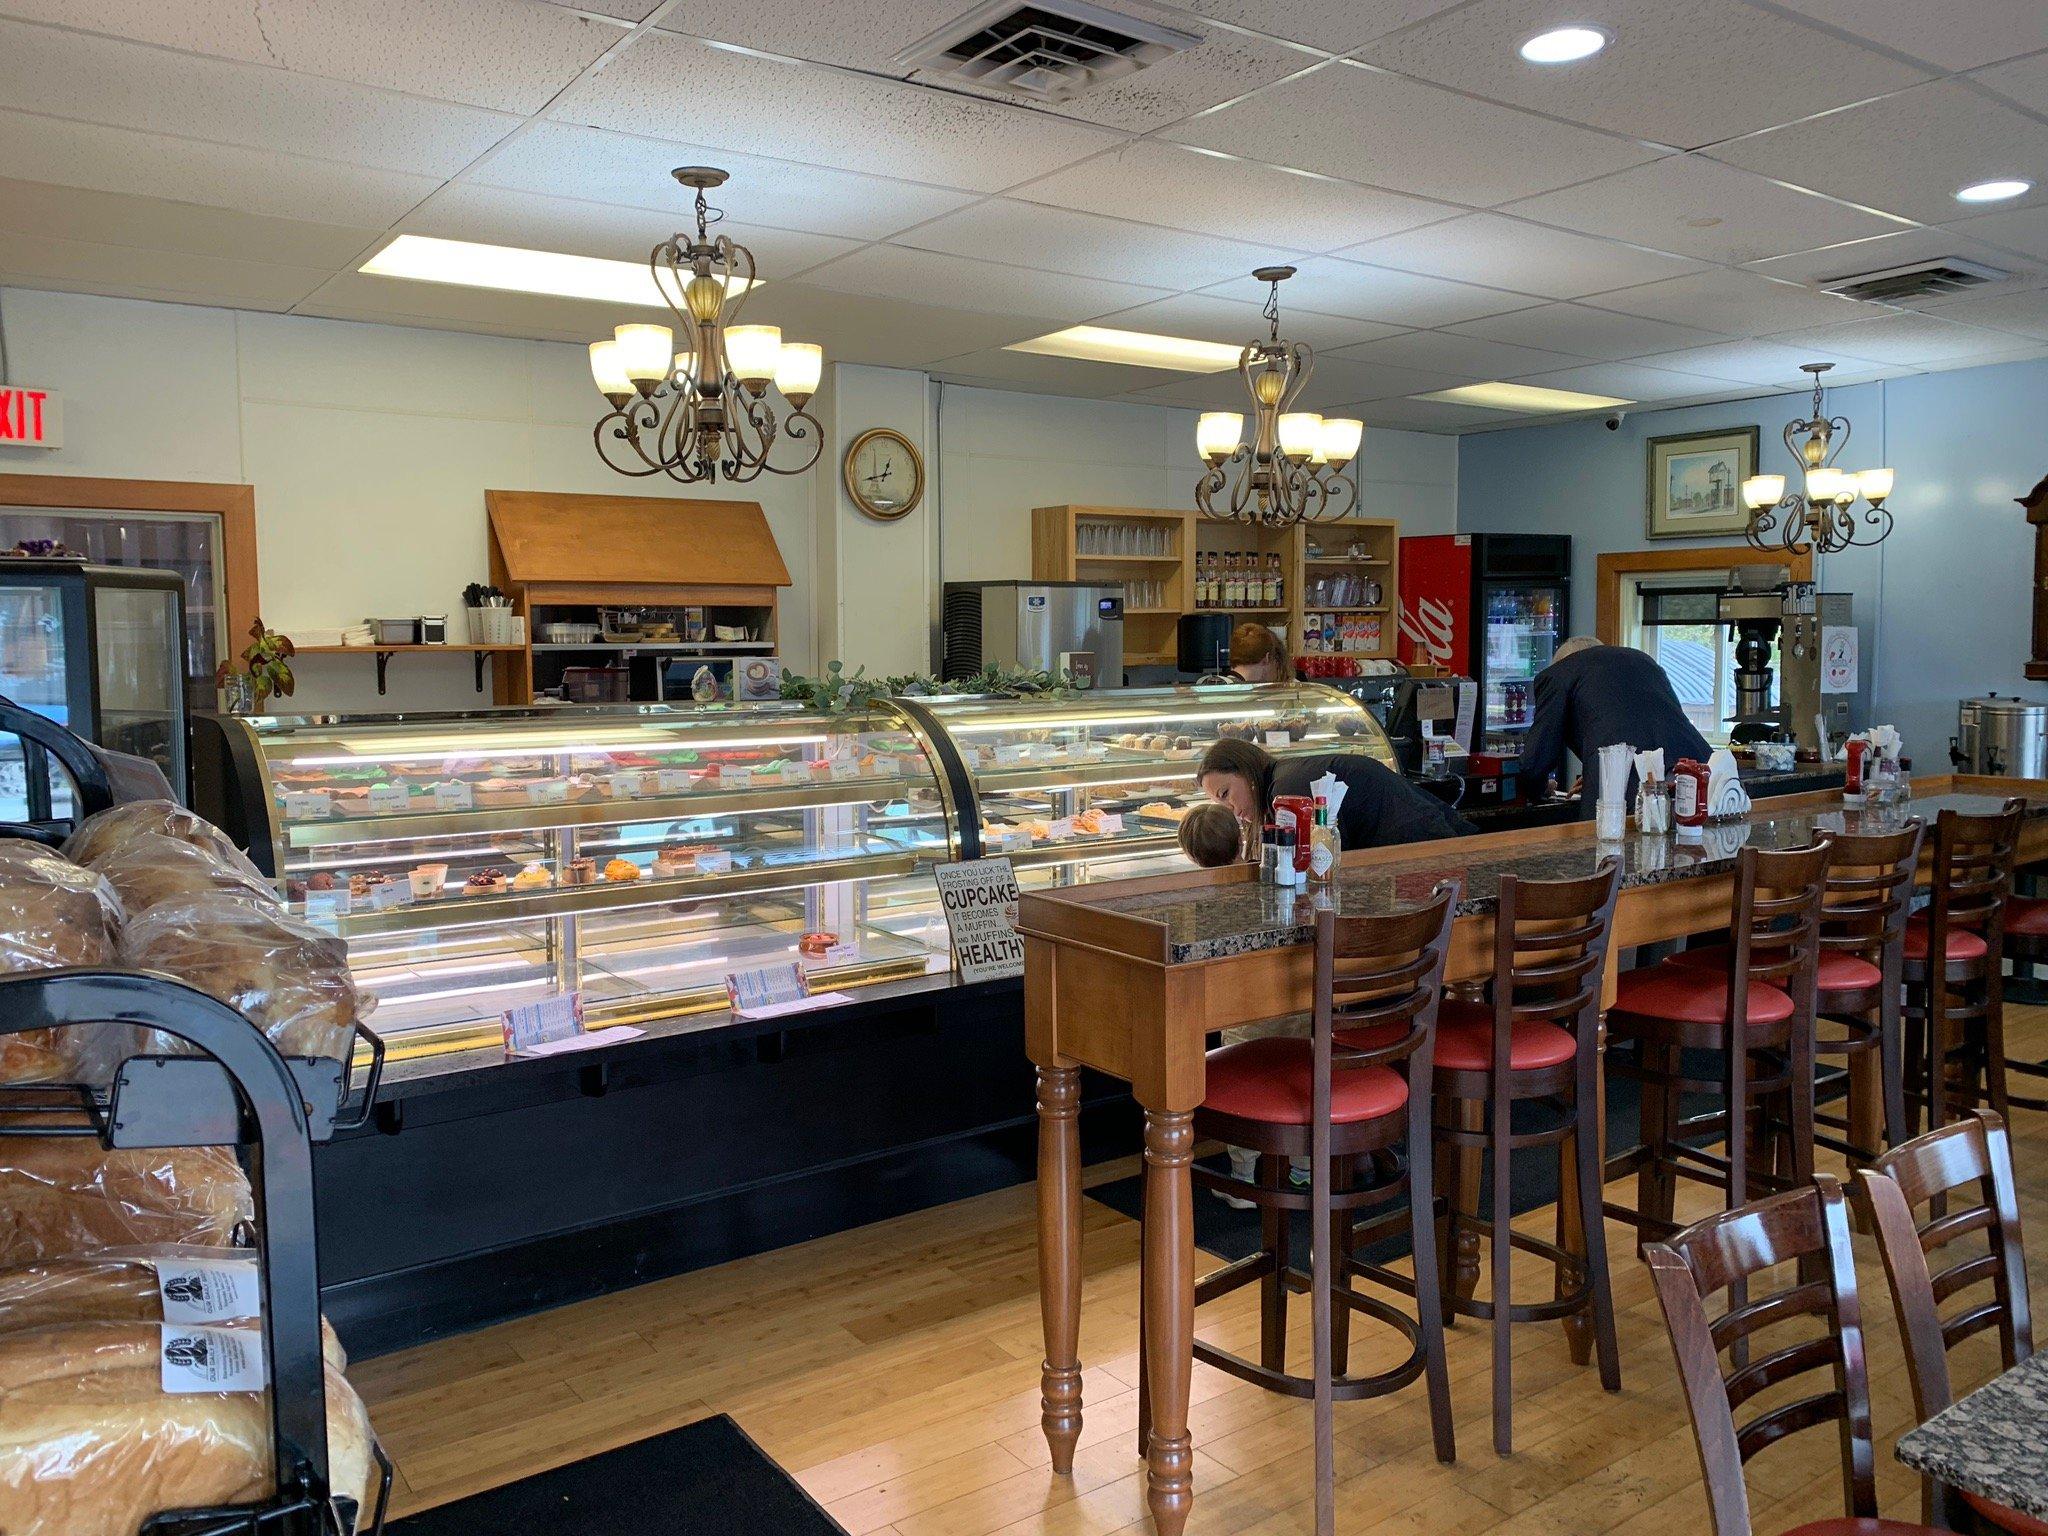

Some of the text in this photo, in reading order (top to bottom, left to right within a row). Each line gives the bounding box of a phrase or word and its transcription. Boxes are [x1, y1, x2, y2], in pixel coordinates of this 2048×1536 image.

[940, 865, 1010, 880] ONCE YOU LICK THE
[942, 878, 979, 890] FROSTING
[980, 876, 994, 886] OFF
[995, 875, 1005, 883] OF
[944, 884, 1018, 909] CUPCAKE
[953, 907, 999, 921] IT BECOMES
[970, 928, 1015, 943] MUFFINS
